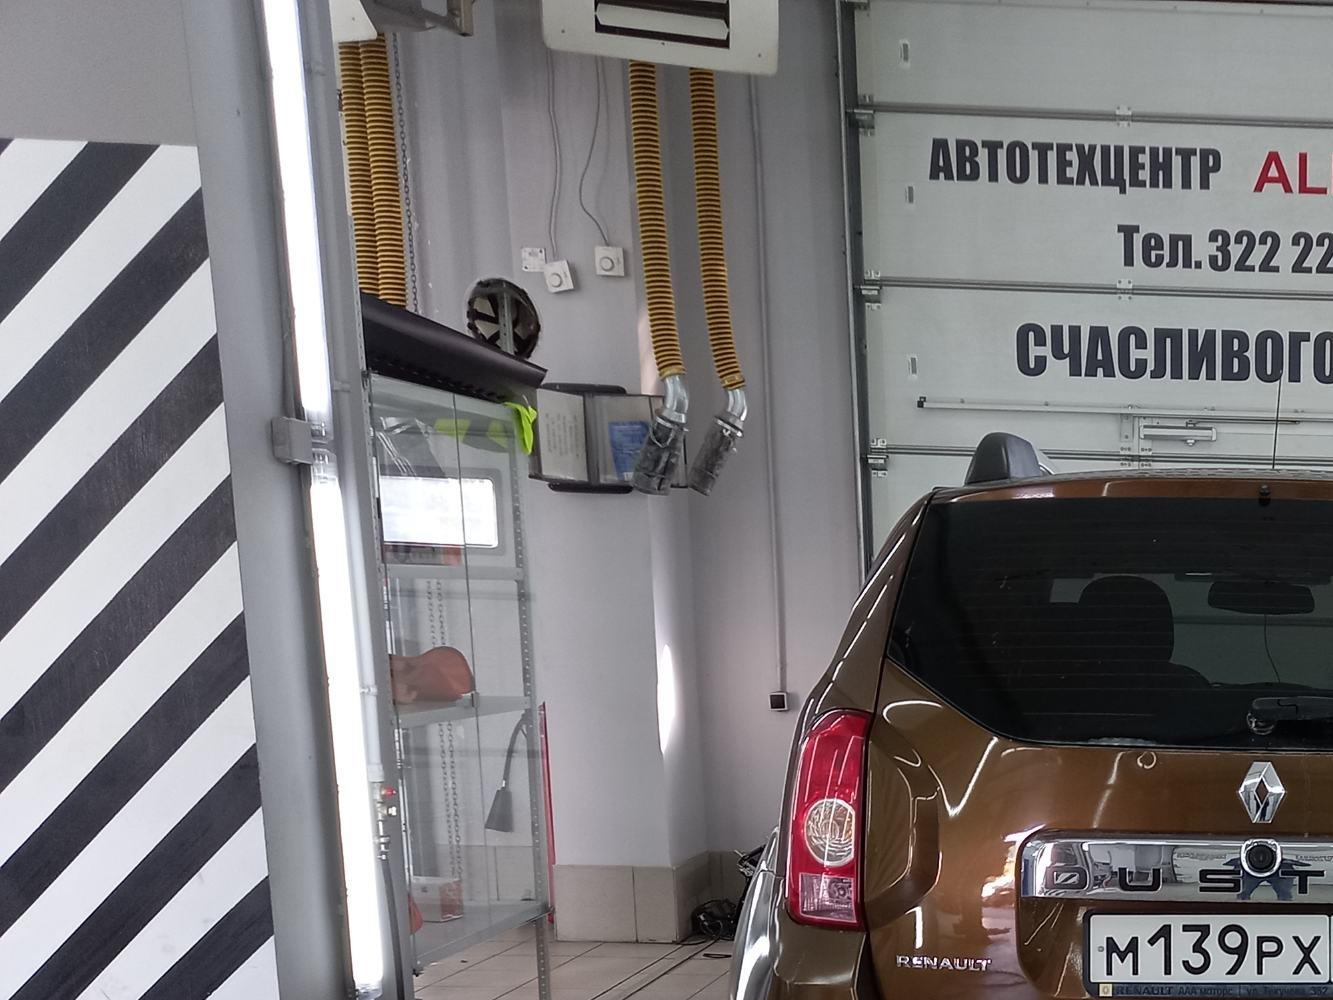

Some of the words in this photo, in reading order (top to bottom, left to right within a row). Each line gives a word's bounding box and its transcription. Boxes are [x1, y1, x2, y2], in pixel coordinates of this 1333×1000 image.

[929, 137, 1222, 194] АВТОТЕХЦЕНТР
[896, 955, 992, 971] RENAULT
[1106, 923, 1321, 977] М139РХ
[1116, 985, 1173, 996] RENAULT
